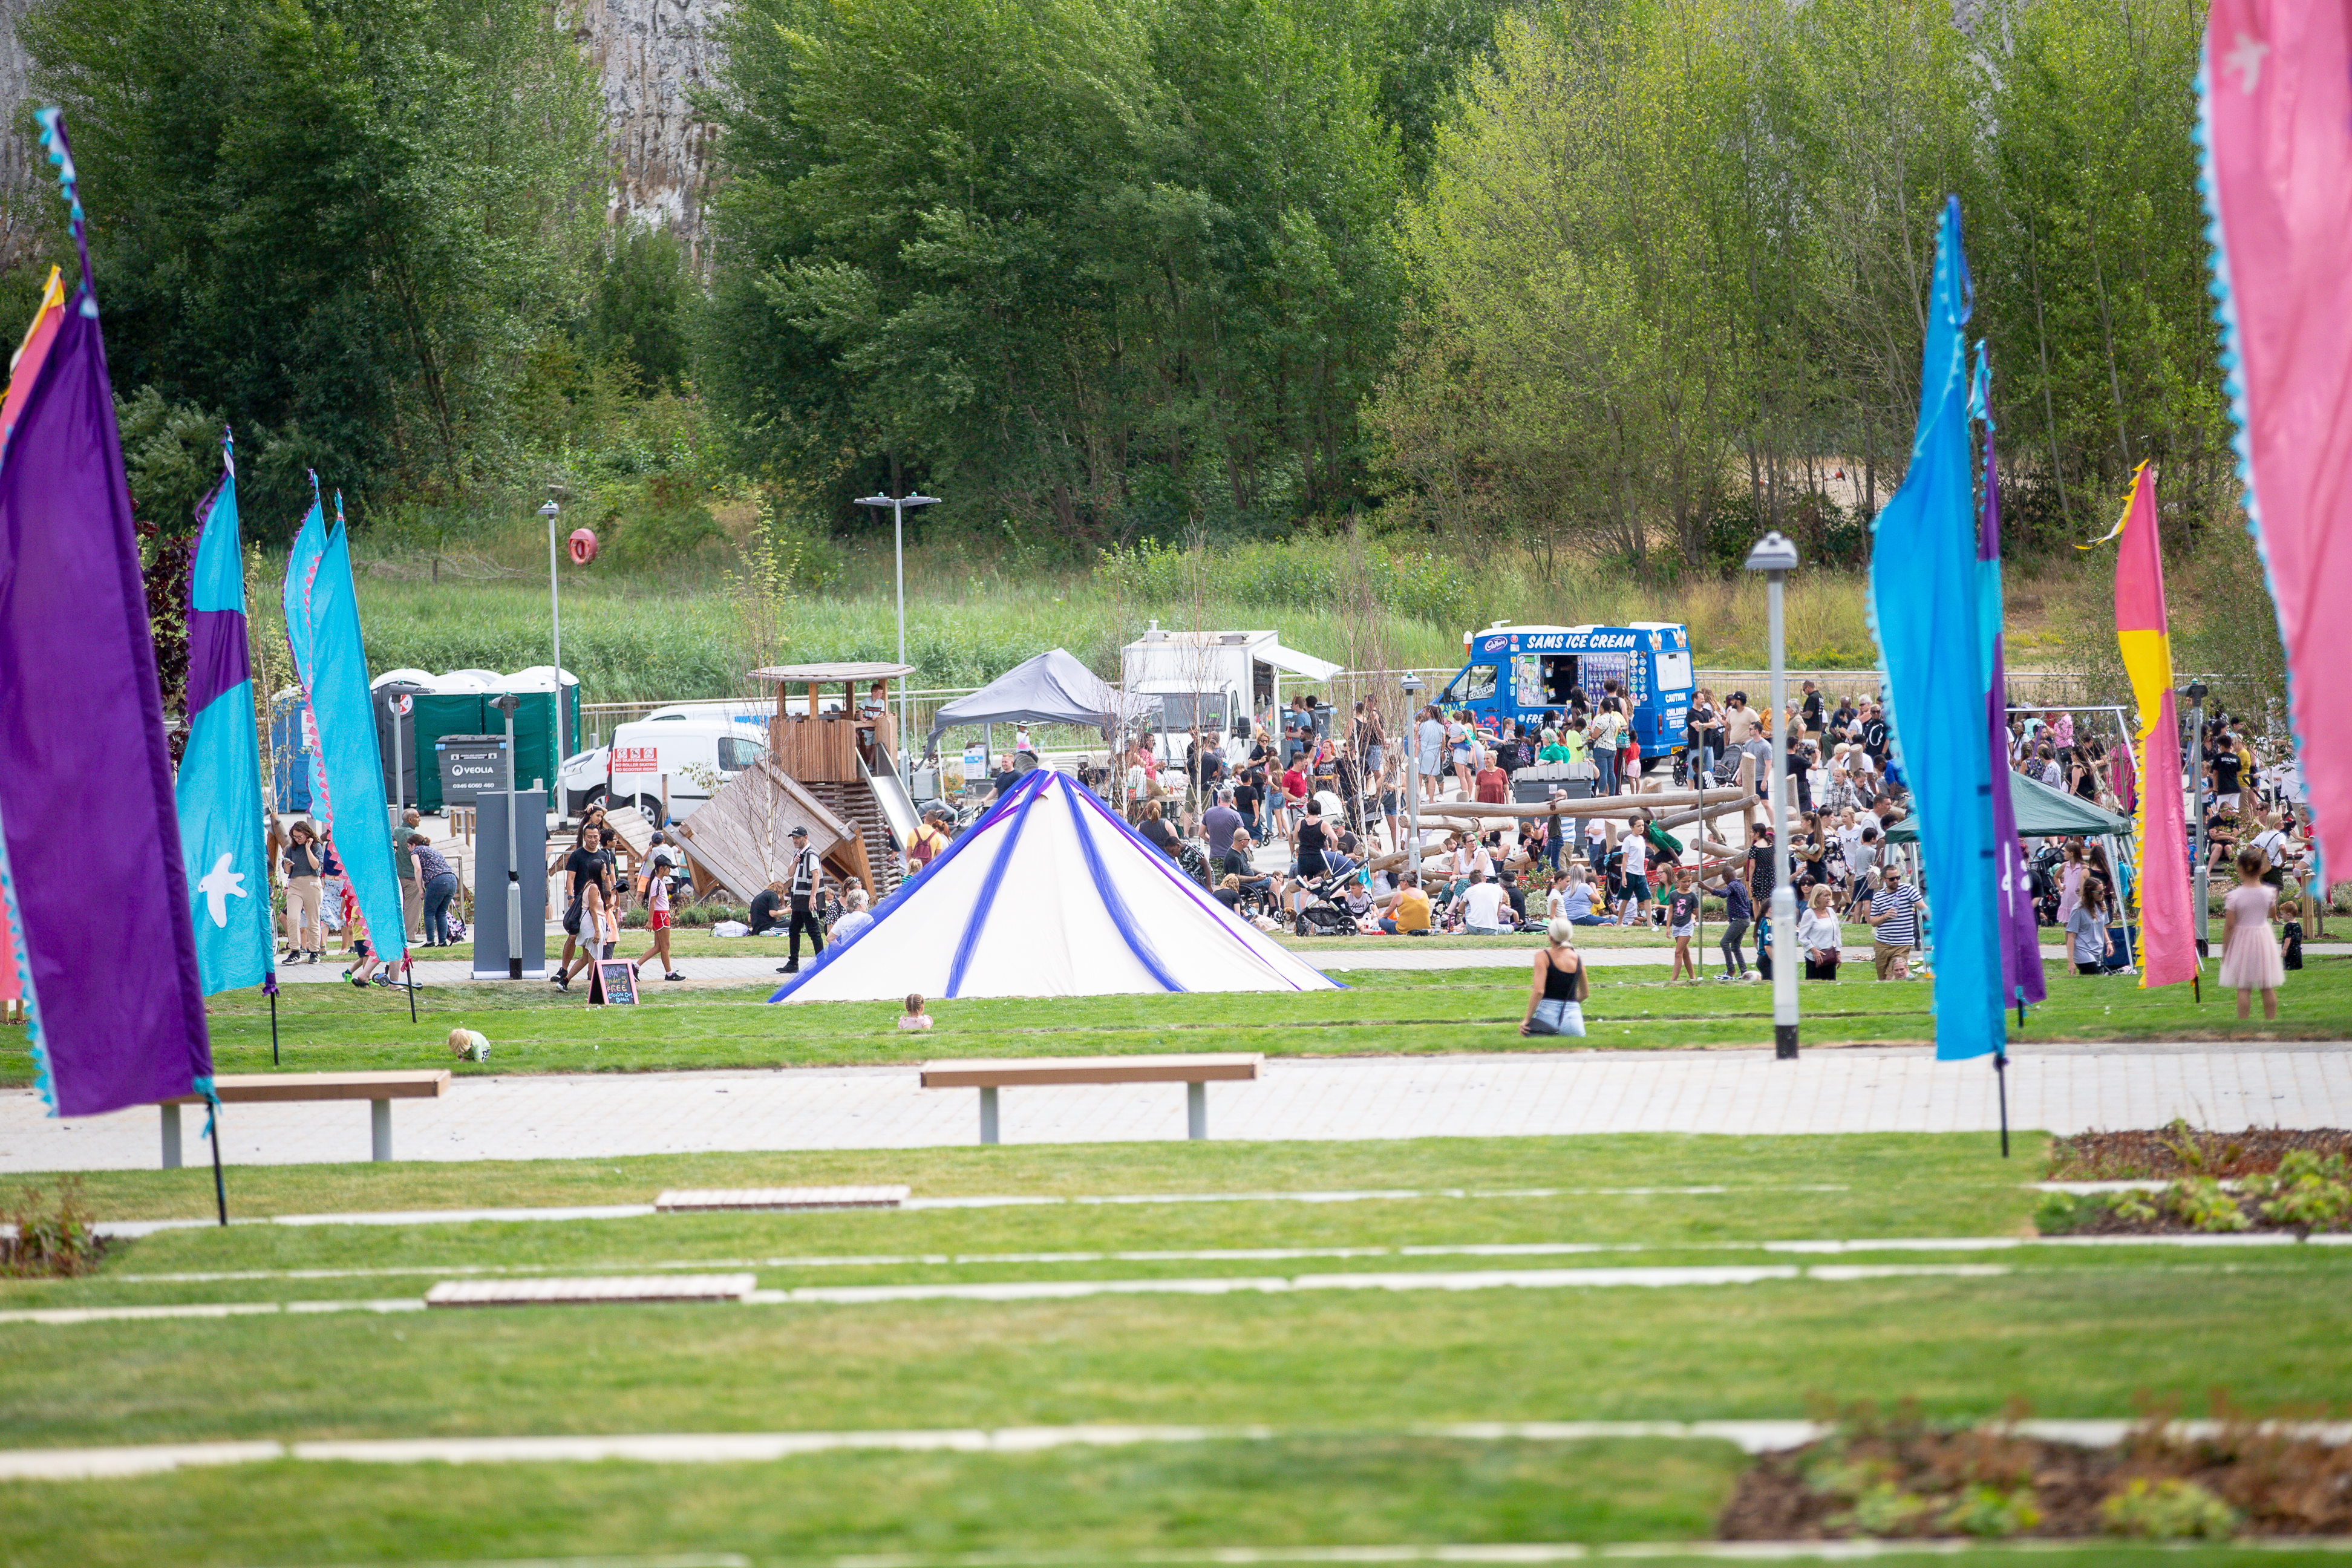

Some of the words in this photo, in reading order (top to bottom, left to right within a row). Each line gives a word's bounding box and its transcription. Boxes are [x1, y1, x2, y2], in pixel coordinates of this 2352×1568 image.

[1526, 635, 1564, 648] SAMS
[1565, 635, 1589, 648] ICE
[1590, 634, 1636, 648] CREAM
[1469, 690, 1482, 699] COLD
[1483, 685, 1495, 693] CANS
[1665, 692, 1686, 703] CAUTION
[1666, 706, 1687, 717] CHILDREN
